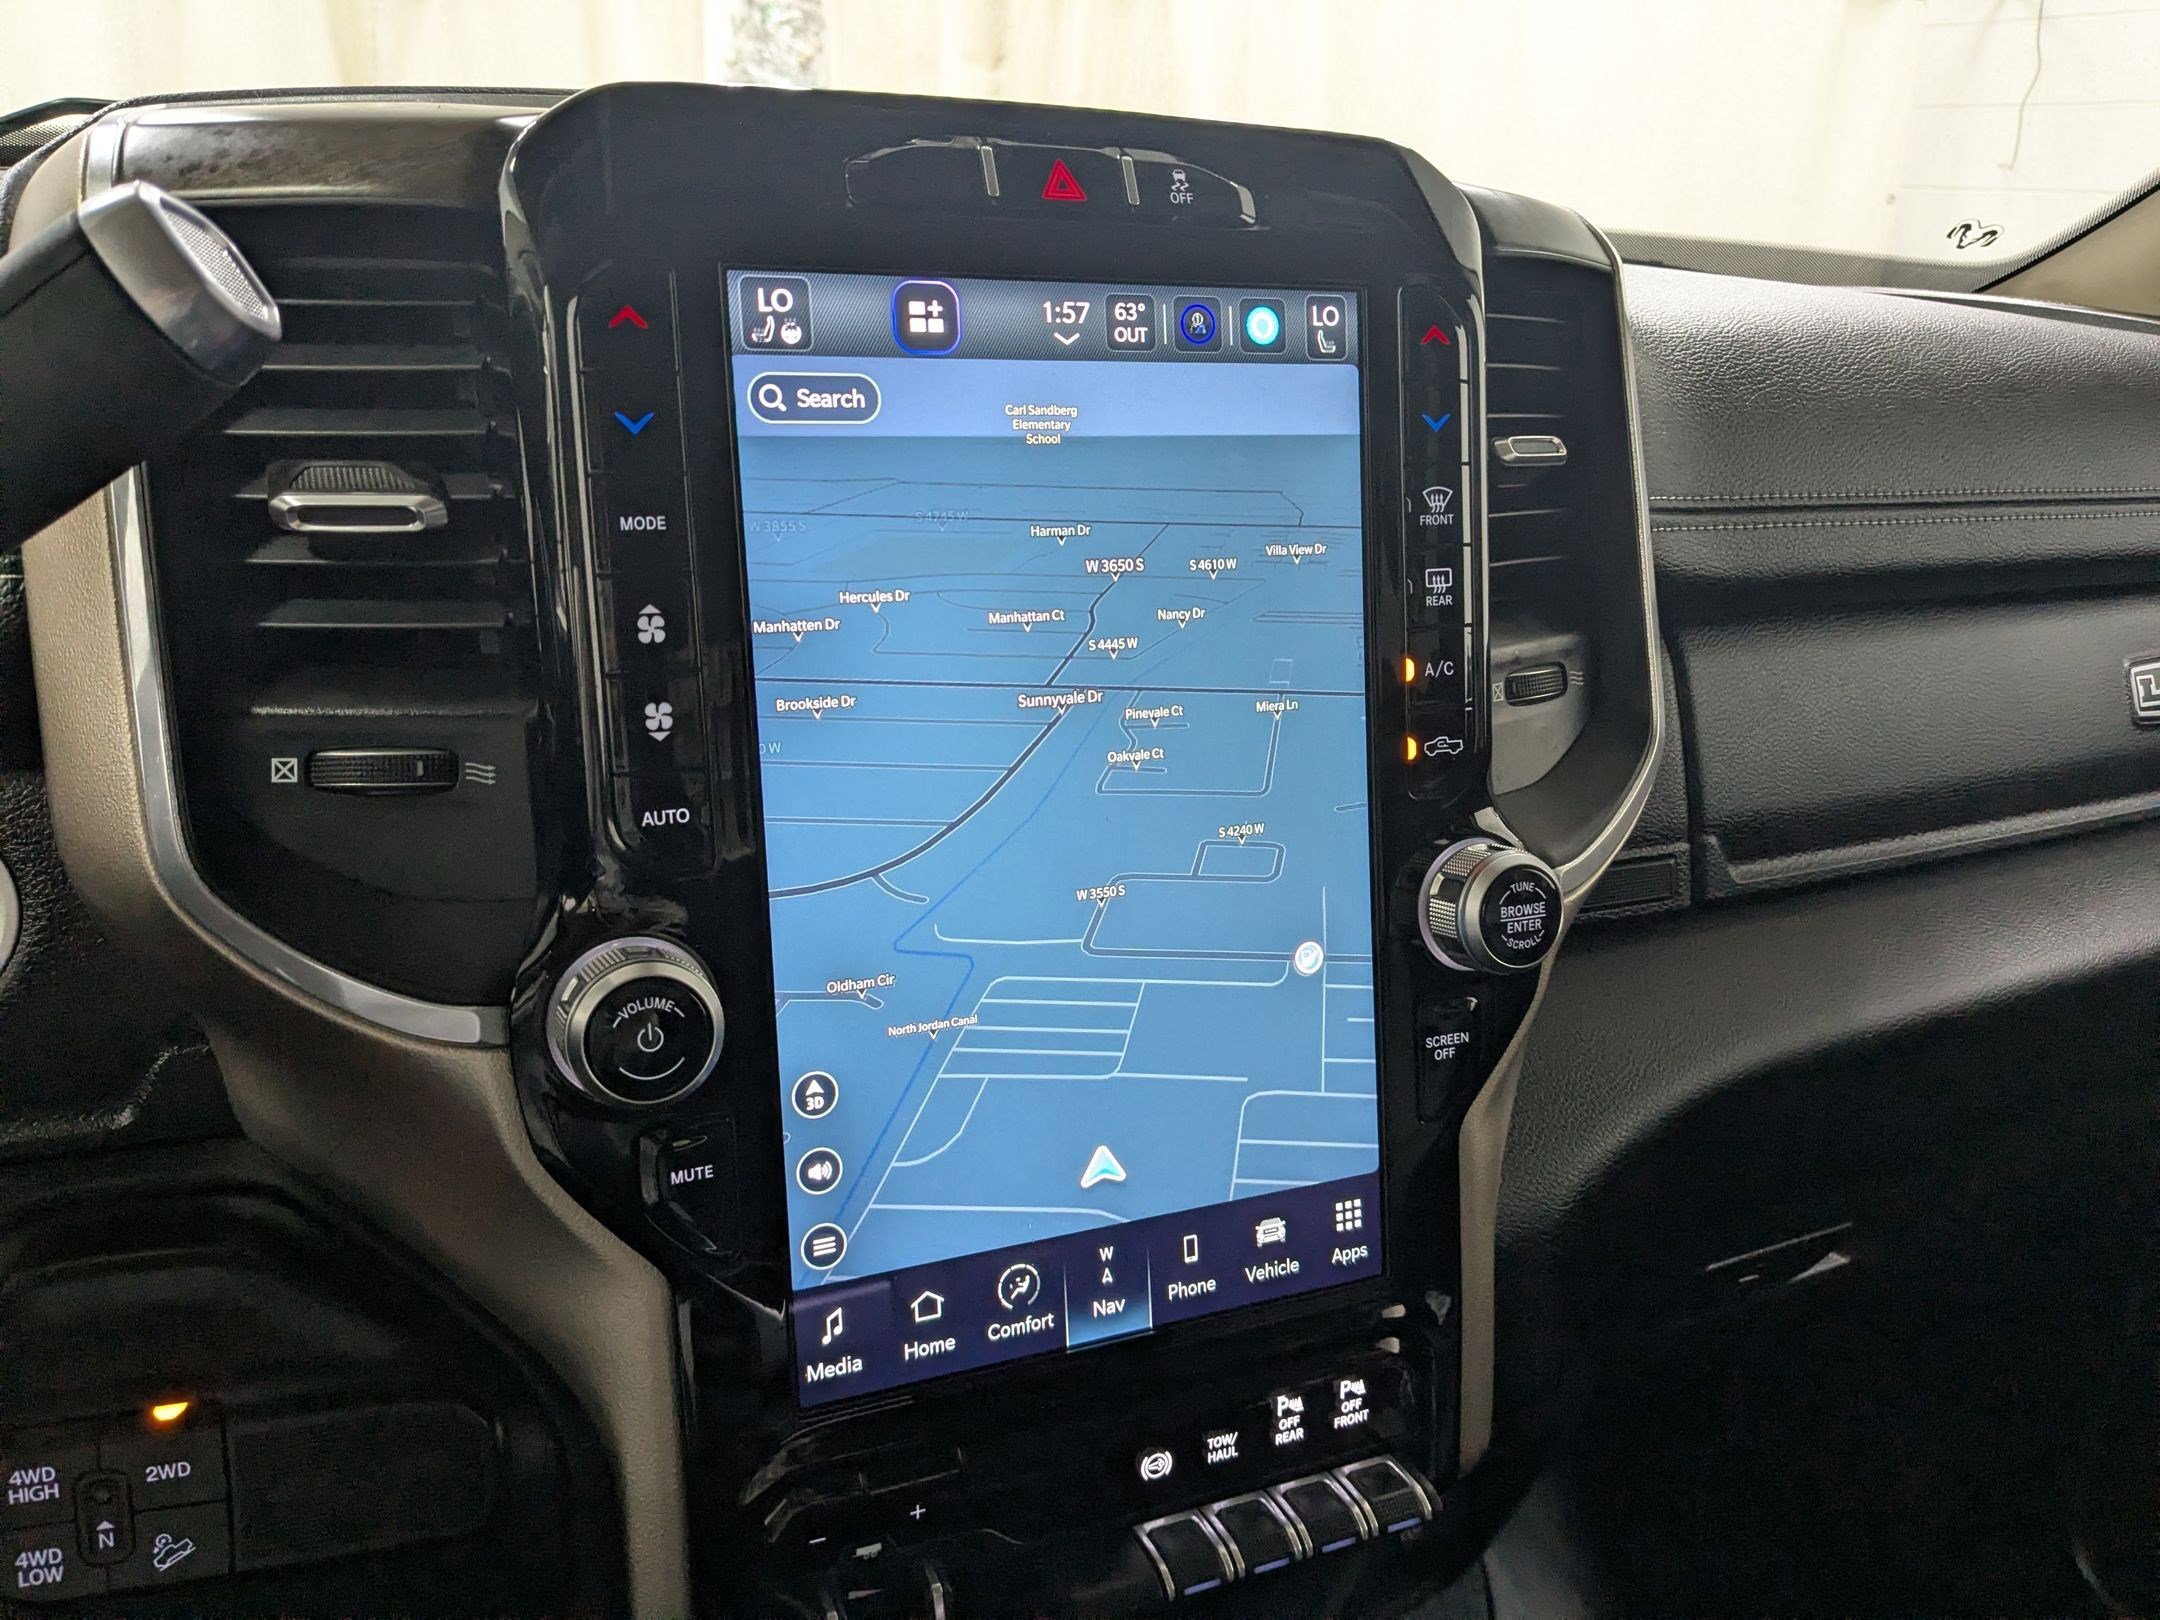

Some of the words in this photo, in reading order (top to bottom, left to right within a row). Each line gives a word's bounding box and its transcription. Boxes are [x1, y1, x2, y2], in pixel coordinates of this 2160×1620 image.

[1170, 192, 1194, 204] OFF
[757, 288, 794, 312] LO
[1042, 301, 1090, 324] 1:57
[1114, 302, 1146, 321] 63°
[1312, 305, 1339, 327] LO
[1114, 327, 1148, 343] OUT
[796, 388, 866, 409] Search
[1005, 404, 1026, 416] Carl
[1028, 405, 1078, 417] Sandberg
[1012, 419, 1071, 432] Elementary
[1026, 433, 1061, 444] School
[619, 516, 667, 531] MODE
[1419, 514, 1454, 526] FRONT
[1030, 525, 1075, 537] Harman
[1077, 524, 1091, 536] Dr
[1266, 545, 1287, 557] Villa
[1289, 544, 1313, 556] View
[1315, 543, 1327, 555] Dr
[1085, 560, 1100, 573] W
[1101, 558, 1134, 573] 3650
[1135, 558, 1145, 572] S
[1189, 560, 1197, 571] S
[1198, 558, 1224, 571] 4610
[1224, 558, 1237, 570] W
[839, 590, 893, 604] Hercules
[895, 589, 910, 602] Dr
[1425, 595, 1453, 607] REAR
[988, 611, 1050, 625] Manhattan
[1052, 610, 1065, 622] Ct
[1157, 608, 1190, 622] Nancy
[1192, 607, 1205, 619] Dr
[753, 620, 823, 634] Manhatten
[825, 618, 841, 631] Dr
[1088, 639, 1096, 651] S
[1098, 638, 1126, 650] 4445
[1127, 637, 1138, 649] W
[1425, 661, 1454, 676] A/C
[776, 697, 838, 711] Brookside
[840, 695, 856, 708] Dr
[1017, 692, 1084, 708] Sunnyvale
[1086, 690, 1104, 704] Dr
[1256, 701, 1284, 713] Miera
[1286, 699, 1298, 711] Ln
[1125, 707, 1169, 720] Pinevale
[1170, 705, 1184, 717] Ct
[768, 742, 781, 754] W
[1107, 749, 1150, 763] Oakvale
[1152, 748, 1164, 760] Ct
[641, 808, 690, 828] AUTO
[1218, 826, 1226, 838] S
[1227, 824, 1253, 836] 4240
[1253, 822, 1264, 834] W
[1076, 888, 1088, 901] W
[1089, 886, 1116, 899] 3550
[1117, 884, 1126, 896] S
[1510, 881, 1536, 894] TUNE
[1500, 901, 1546, 918] BROWSE
[1506, 919, 1542, 934] ENTER
[1506, 936, 1542, 950] SCROLL
[826, 978, 875, 994] Oldham
[877, 974, 896, 987] Cir
[618, 997, 675, 1020] VOLUME
[888, 1024, 916, 1036] North
[918, 1019, 949, 1033] Jordan
[951, 1014, 978, 1027] Canal
[1425, 1032, 1470, 1049] SCREEN
[1434, 1048, 1456, 1061] OFF
[806, 1096, 825, 1111] 3D
[670, 1165, 714, 1185] MUTE
[1099, 1246, 1114, 1261] W
[1332, 1244, 1369, 1265] Apps
[1245, 1258, 1300, 1283] Vehicle
[1168, 1278, 1216, 1301] Phone
[1092, 1299, 1126, 1318] Nav
[988, 1312, 1055, 1341] Comfort
[904, 1336, 956, 1361] Home
[806, 1356, 863, 1383] Media
[1341, 1398, 1362, 1413] OFF
[1278, 1415, 1300, 1431] OFF
[1334, 1409, 1369, 1429] FRONT
[1207, 1432, 1238, 1450] TOW/
[1275, 1428, 1304, 1446] REAR
[1207, 1446, 1238, 1464] HAUL
[9, 1466, 56, 1486] 4WD
[145, 1461, 191, 1482] 2WD
[8, 1484, 60, 1505] HIGH
[99, 1532, 115, 1549] N
[14, 1548, 63, 1569] 4WD
[18, 1566, 64, 1588] LOW
